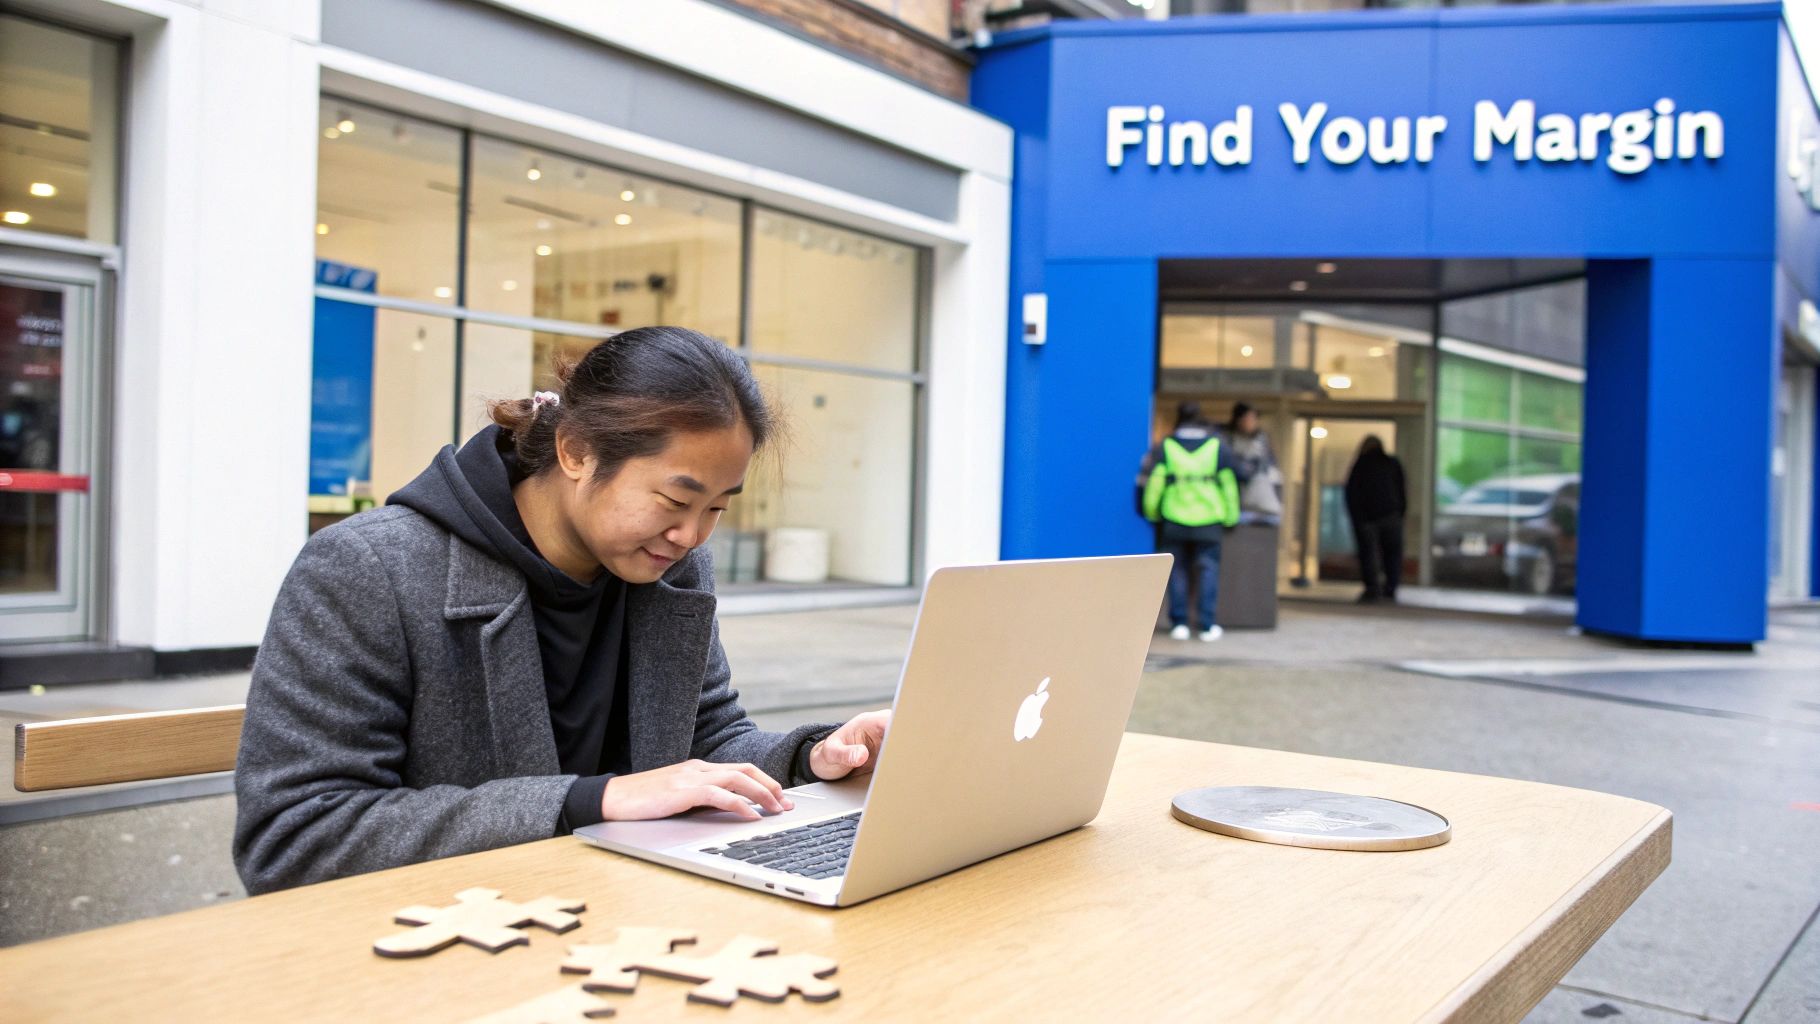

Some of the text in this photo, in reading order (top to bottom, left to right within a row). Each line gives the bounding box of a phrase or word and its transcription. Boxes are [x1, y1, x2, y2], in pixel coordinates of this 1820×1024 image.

[1105, 104, 1253, 167] Find
[1278, 101, 1448, 164] Your
[1474, 98, 1724, 174] Margin
